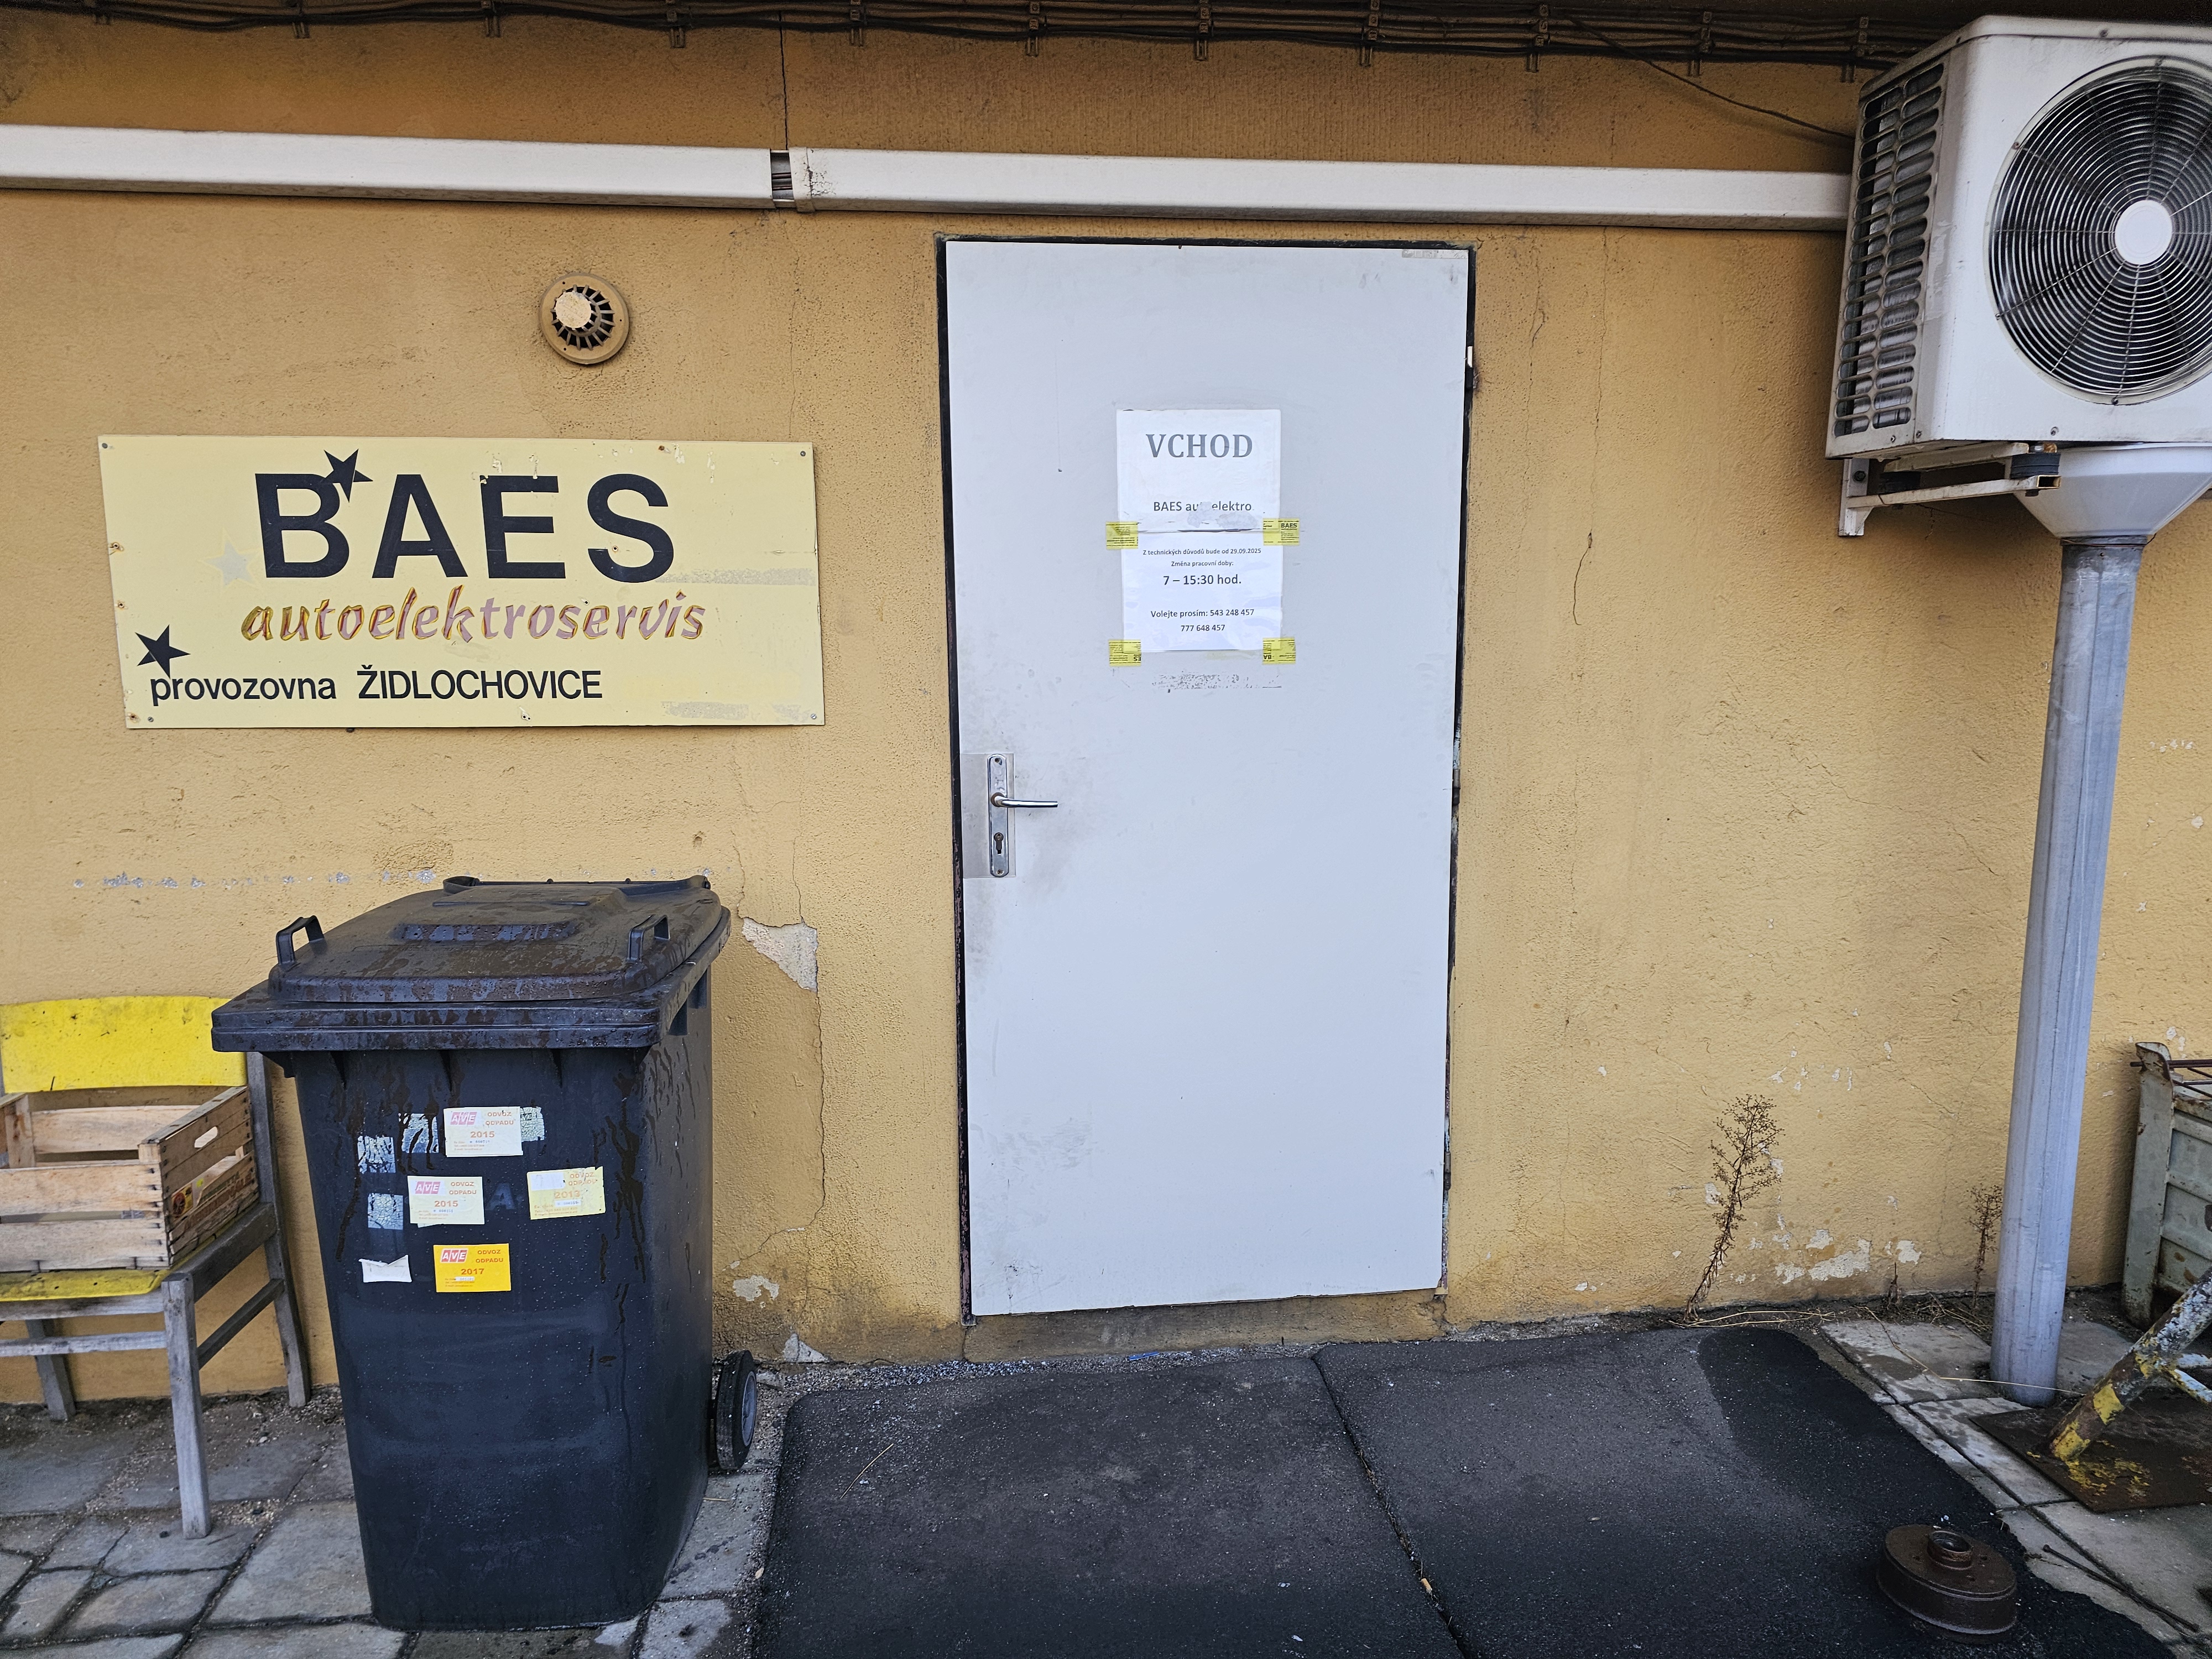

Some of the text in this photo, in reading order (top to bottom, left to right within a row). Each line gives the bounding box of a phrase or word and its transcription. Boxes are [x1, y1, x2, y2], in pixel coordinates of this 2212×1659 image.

[1146, 434, 1253, 458] VCHOD
[1154, 501, 1252, 512] BAES auelektro
[255, 473, 674, 583] BAES
[1163, 576, 1170, 585] 7
[1183, 575, 1214, 585] 15:30
[1217, 573, 1242, 585] hod.
[241, 585, 706, 643] autoelektroservis
[1150, 610, 1178, 619] Volejte
[1180, 609, 1208, 618] prosím:
[150, 664, 603, 707] provozovna ŽIDLOCHOVICE
[451, 1114, 476, 1123] AVE
[415, 1183, 440, 1192] AVE
[554, 1190, 581, 1199] 2013
[442, 1251, 467, 1260] AVE
